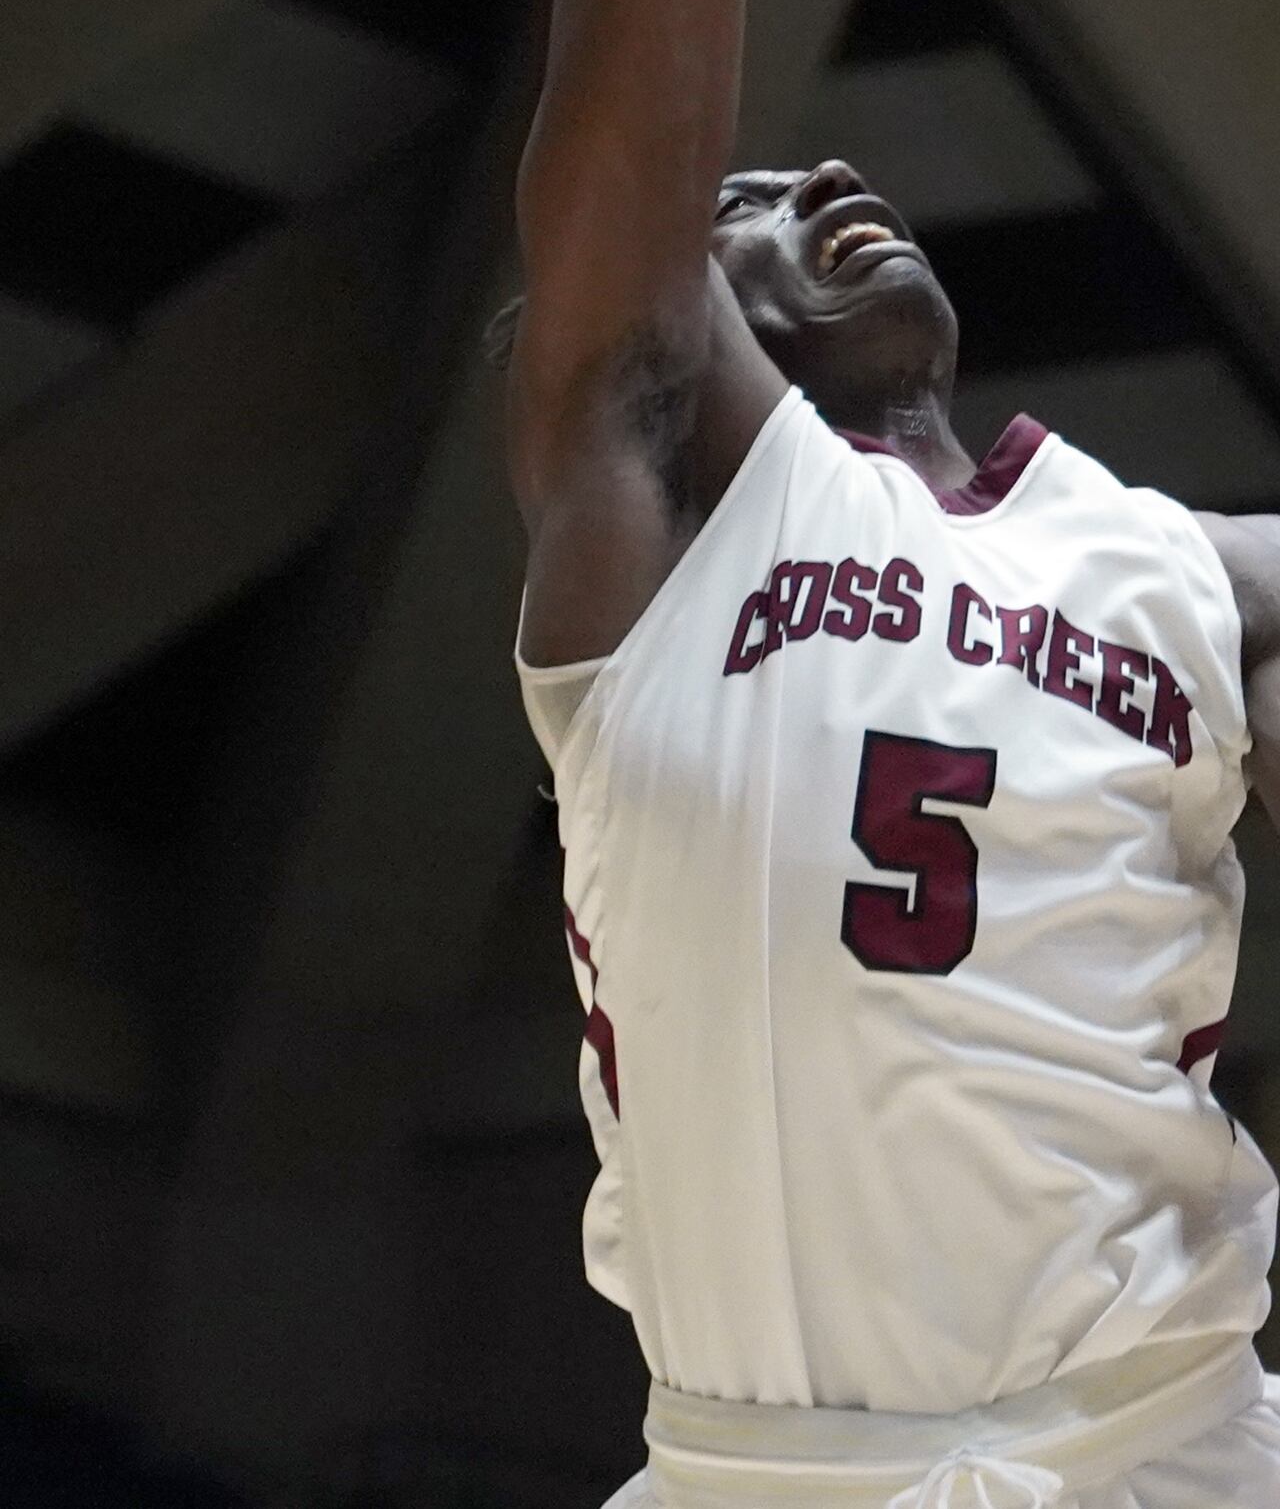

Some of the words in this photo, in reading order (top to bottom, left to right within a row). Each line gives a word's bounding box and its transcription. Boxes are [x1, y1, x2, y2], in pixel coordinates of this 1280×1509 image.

[723, 557, 924, 676] CROSS
[946, 582, 1193, 768] CREEK
[840, 729, 997, 976] 5
